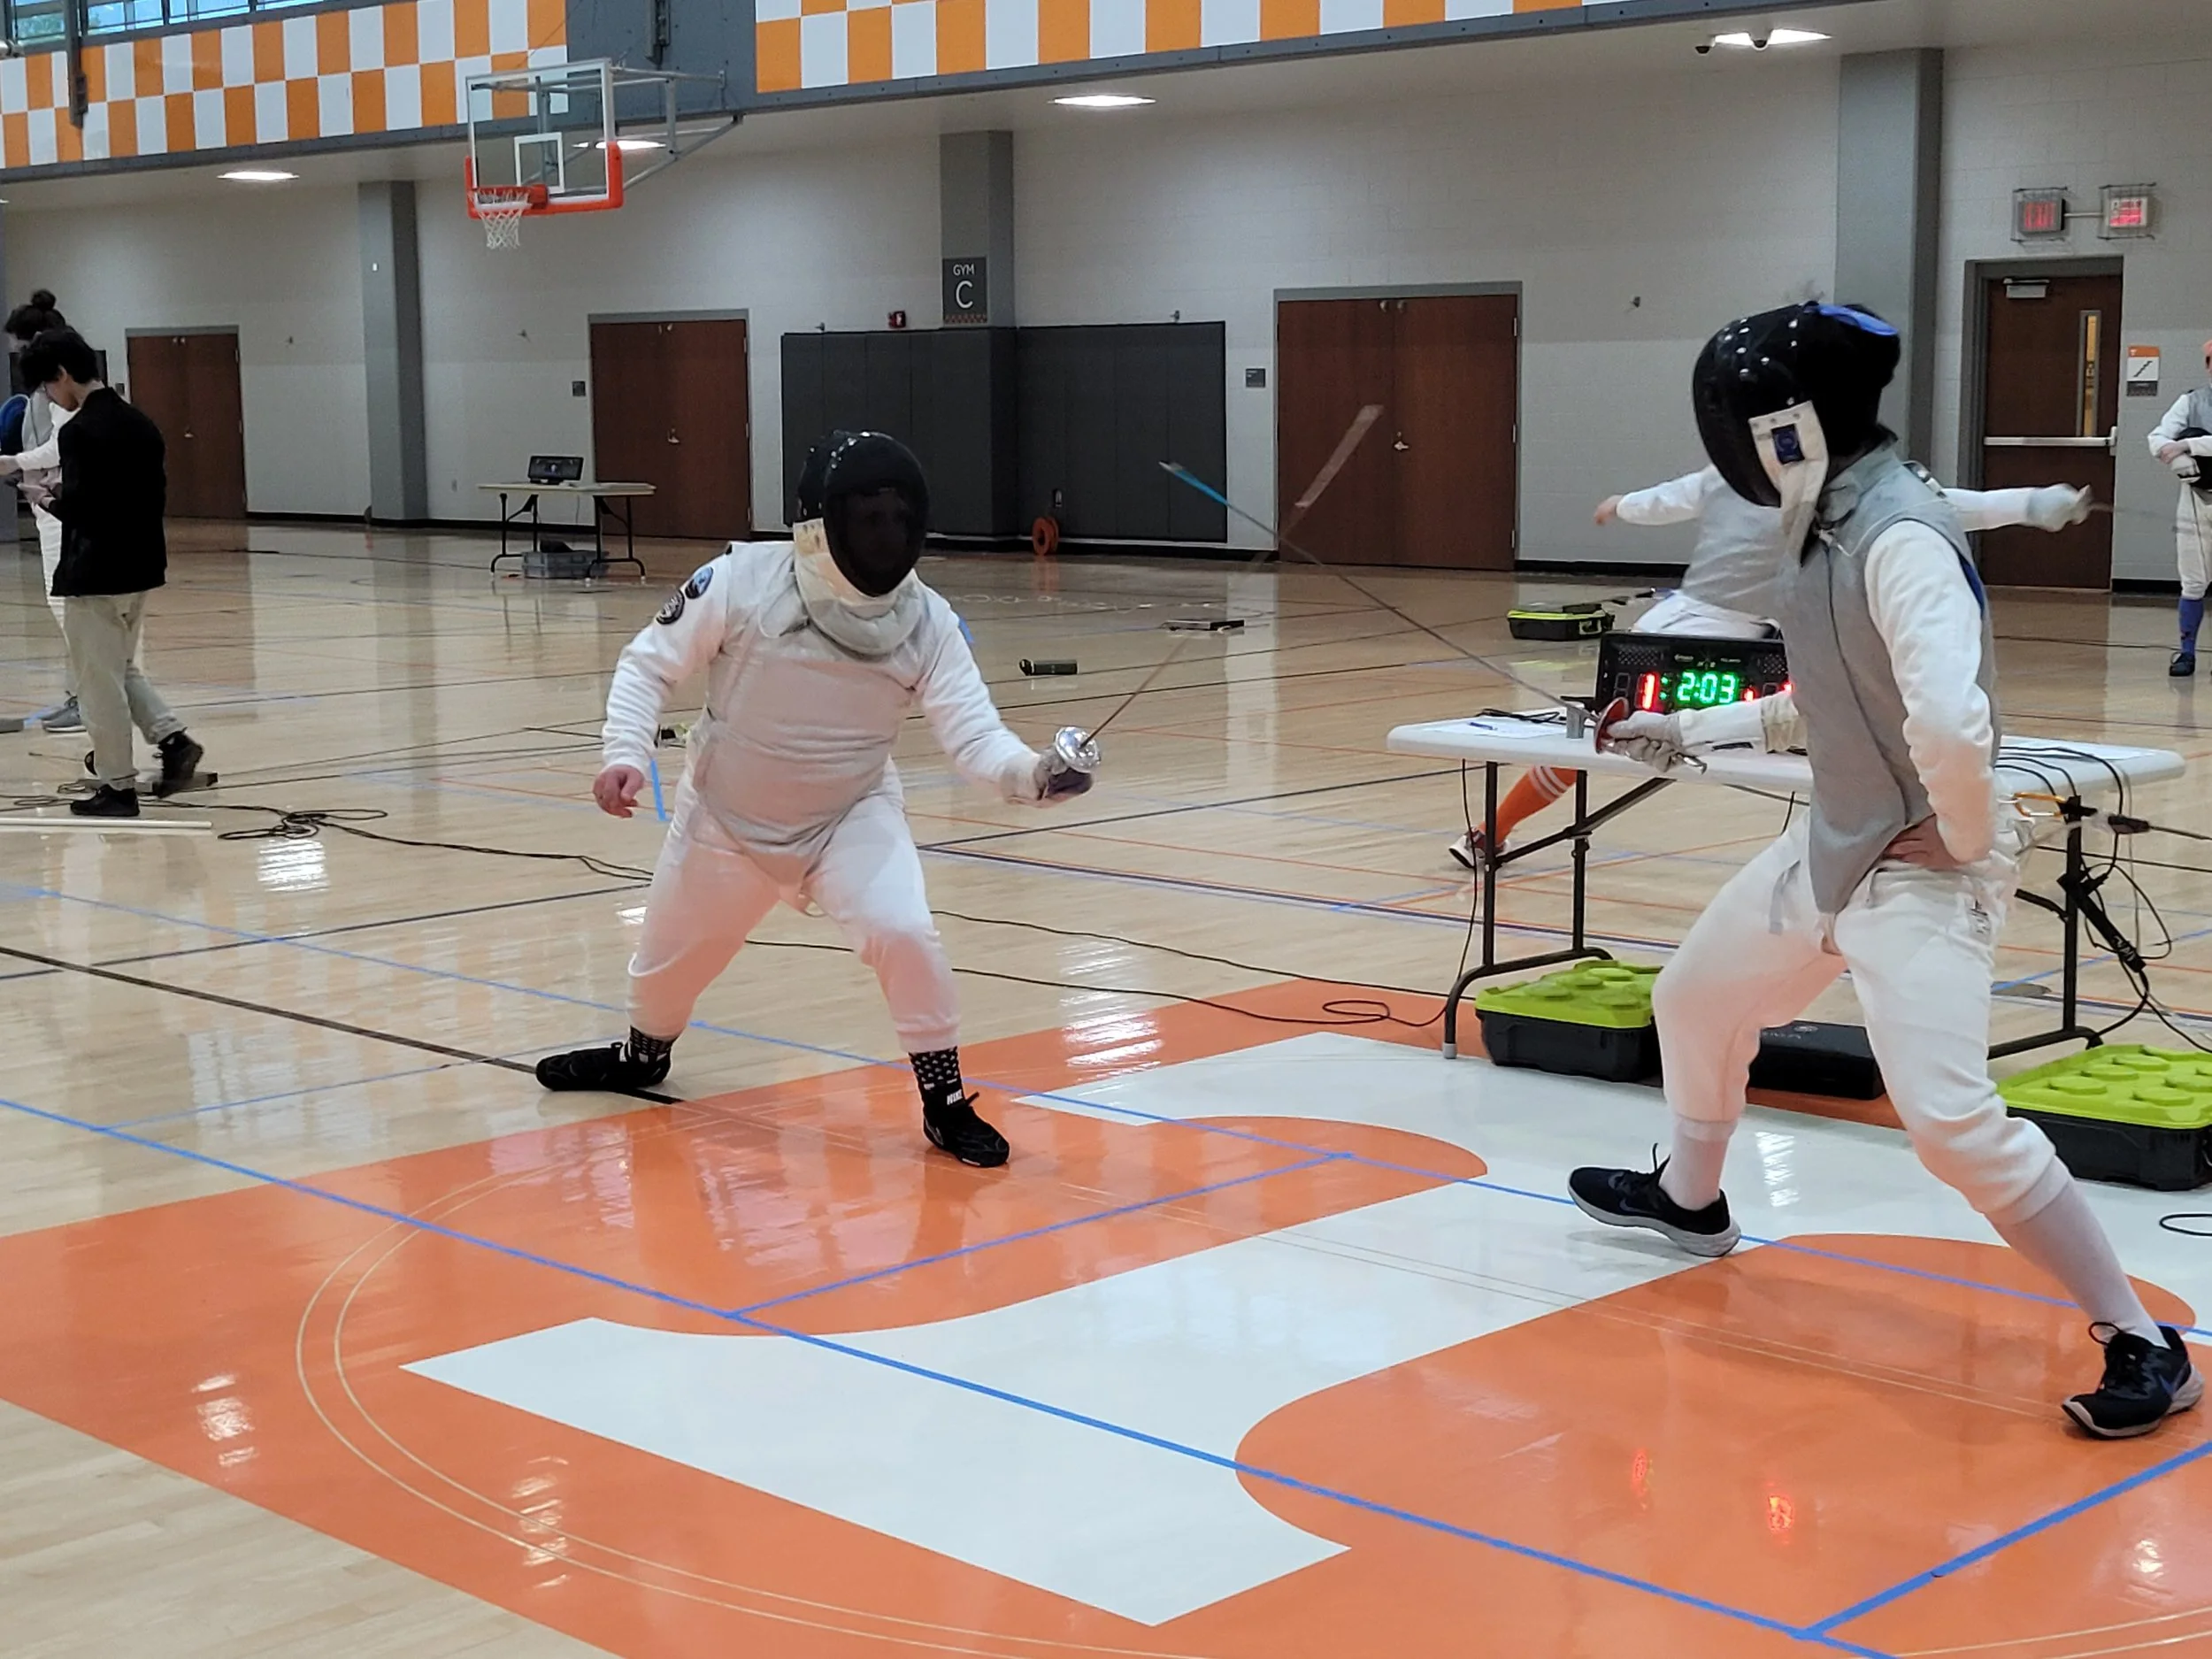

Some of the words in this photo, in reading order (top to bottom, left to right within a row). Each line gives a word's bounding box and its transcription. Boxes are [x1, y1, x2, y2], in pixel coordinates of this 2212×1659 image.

[953, 264, 974, 276] GYM
[956, 280, 973, 309] C
[1676, 671, 1736, 705] 2:03
